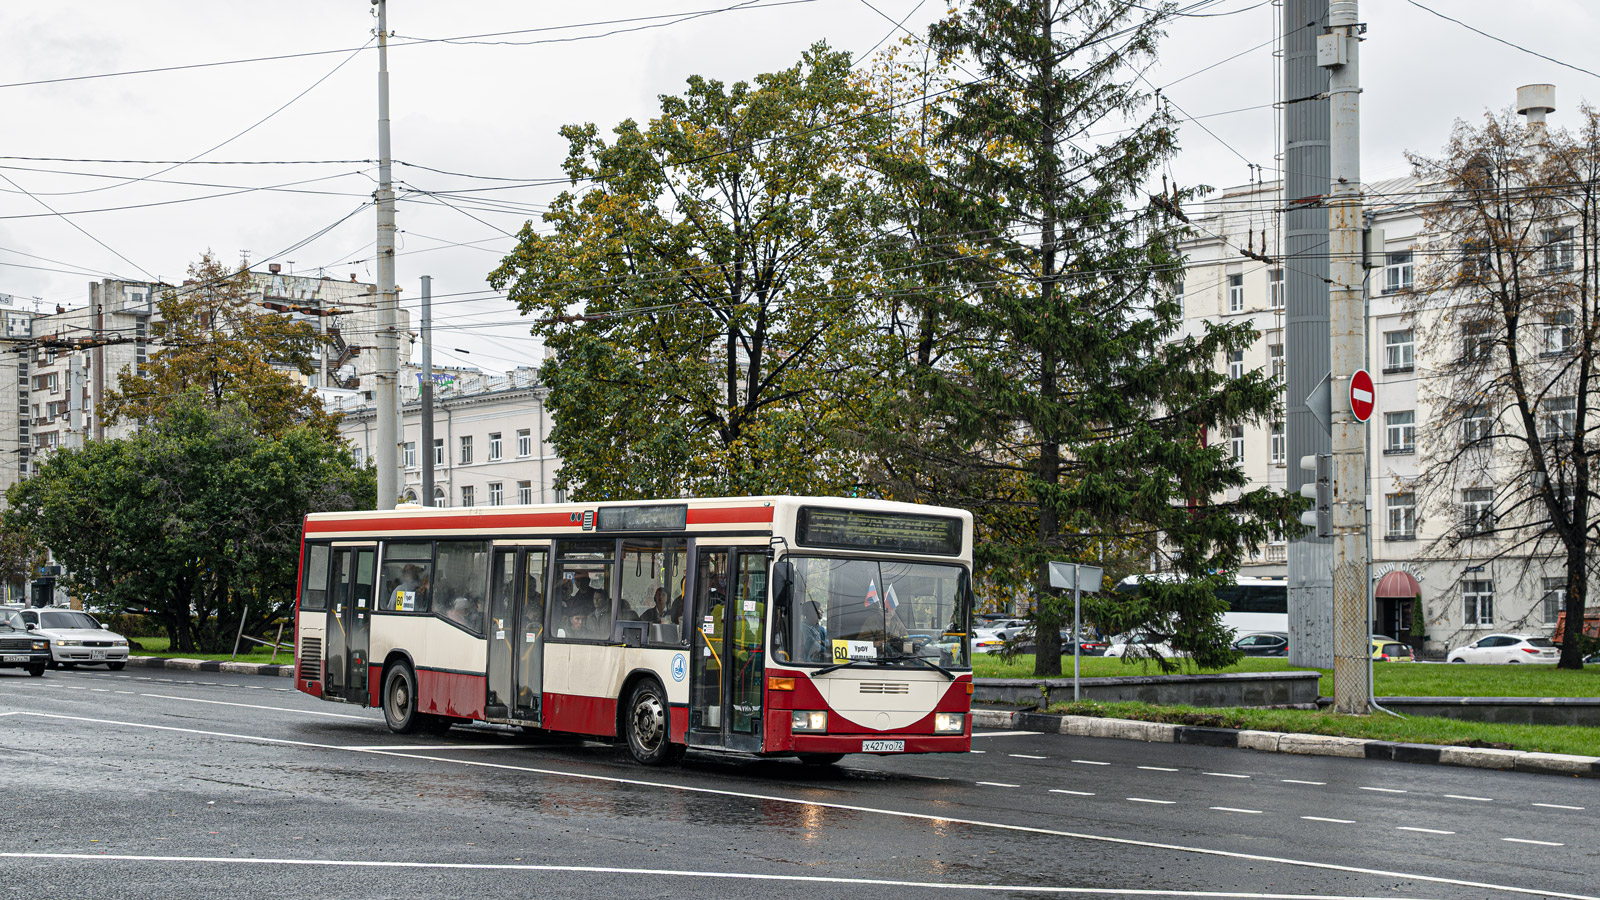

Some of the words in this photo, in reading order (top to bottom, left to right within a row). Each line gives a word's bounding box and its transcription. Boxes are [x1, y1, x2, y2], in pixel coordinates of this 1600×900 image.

[1374, 562, 1395, 581] SHOW
[1400, 562, 1425, 582] GIRLS
[396, 596, 403, 606] 60
[834, 646, 847, 659] 60
[854, 645, 868, 653] УрФУ
